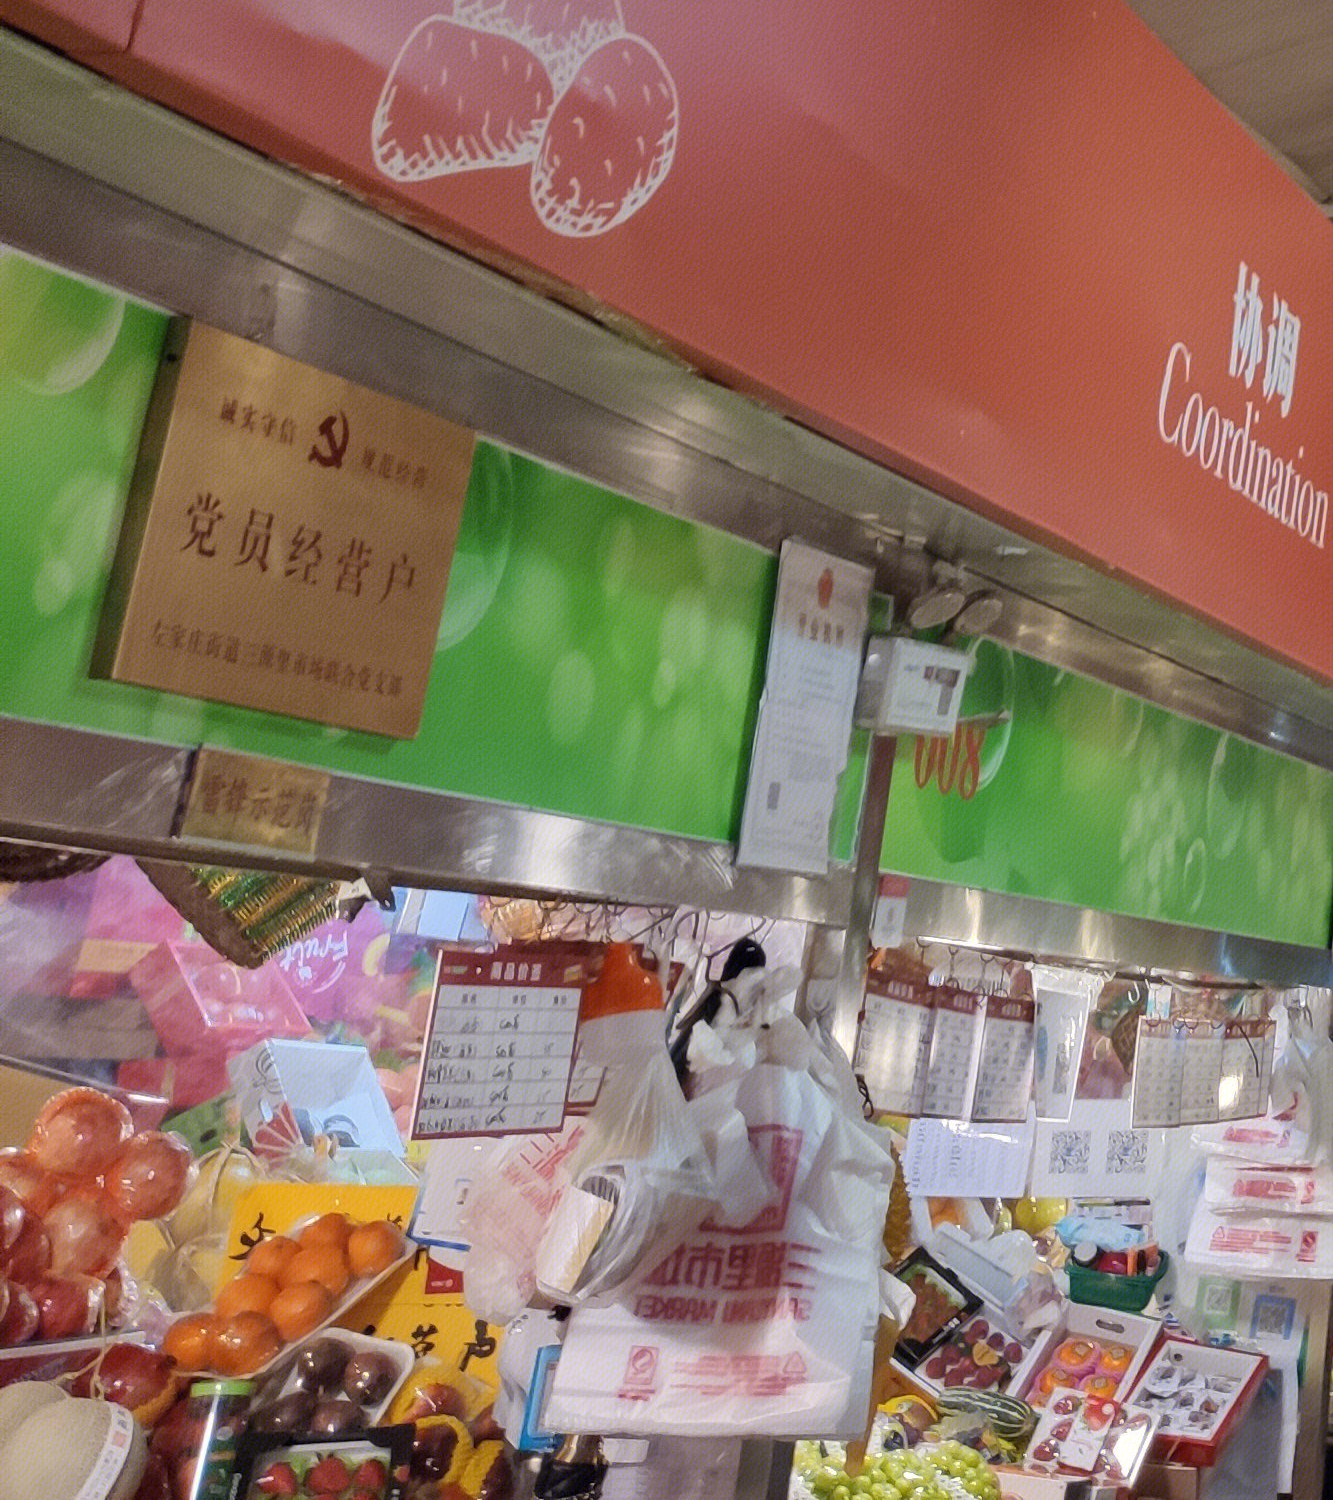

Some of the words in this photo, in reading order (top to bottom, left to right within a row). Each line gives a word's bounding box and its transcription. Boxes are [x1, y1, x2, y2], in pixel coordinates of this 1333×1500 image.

[1228, 260, 1301, 419] 协调
[1158, 341, 1330, 549] Coordination
[179, 493, 421, 606] 党员经营户
